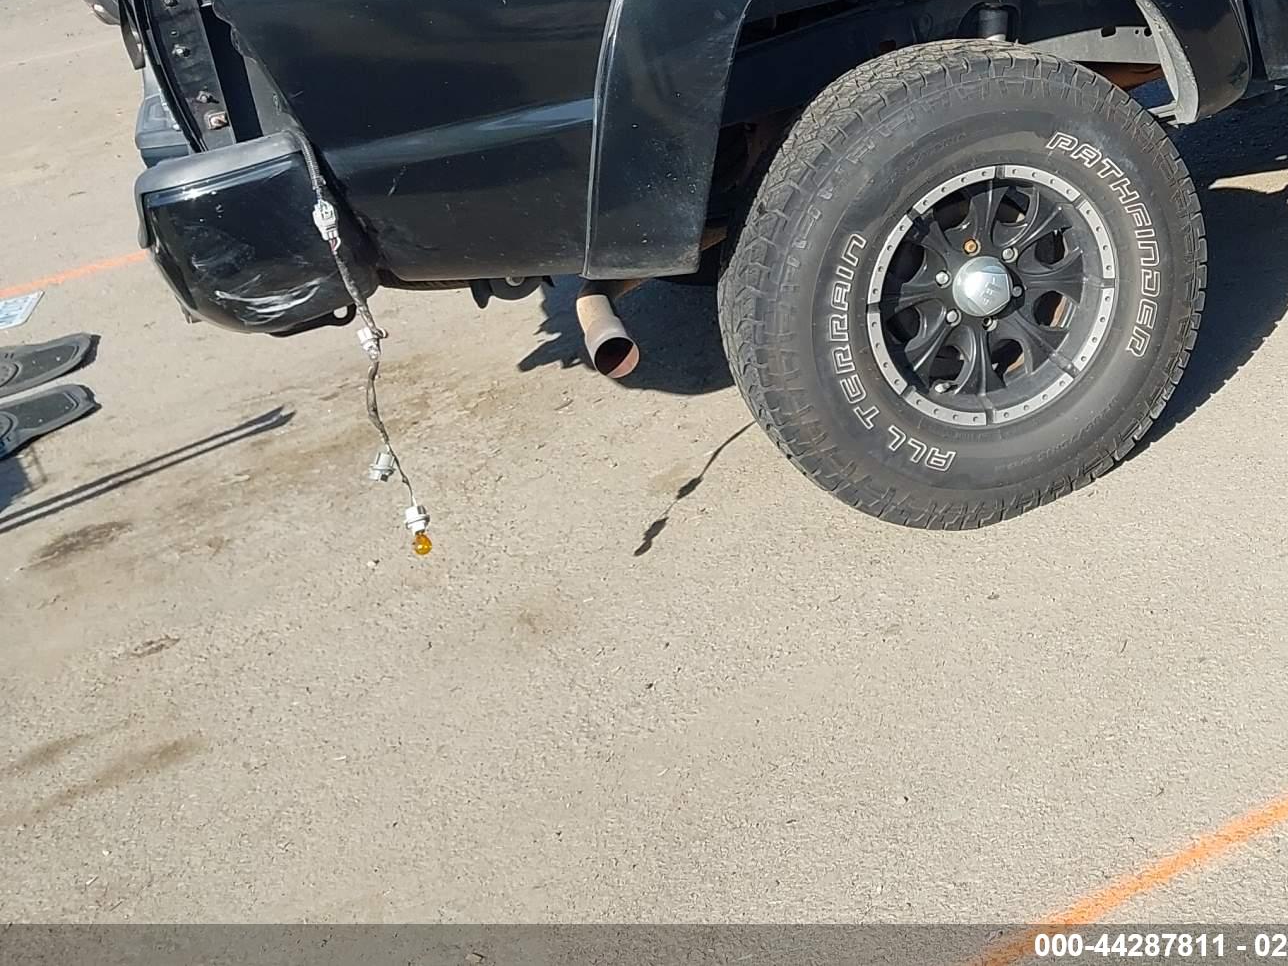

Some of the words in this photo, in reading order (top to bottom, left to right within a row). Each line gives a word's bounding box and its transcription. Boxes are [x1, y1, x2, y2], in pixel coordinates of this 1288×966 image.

[829, 233, 876, 431] TERRAIN
[1046, 131, 1162, 358] PATHFINDER
[887, 425, 957, 472] ALL
